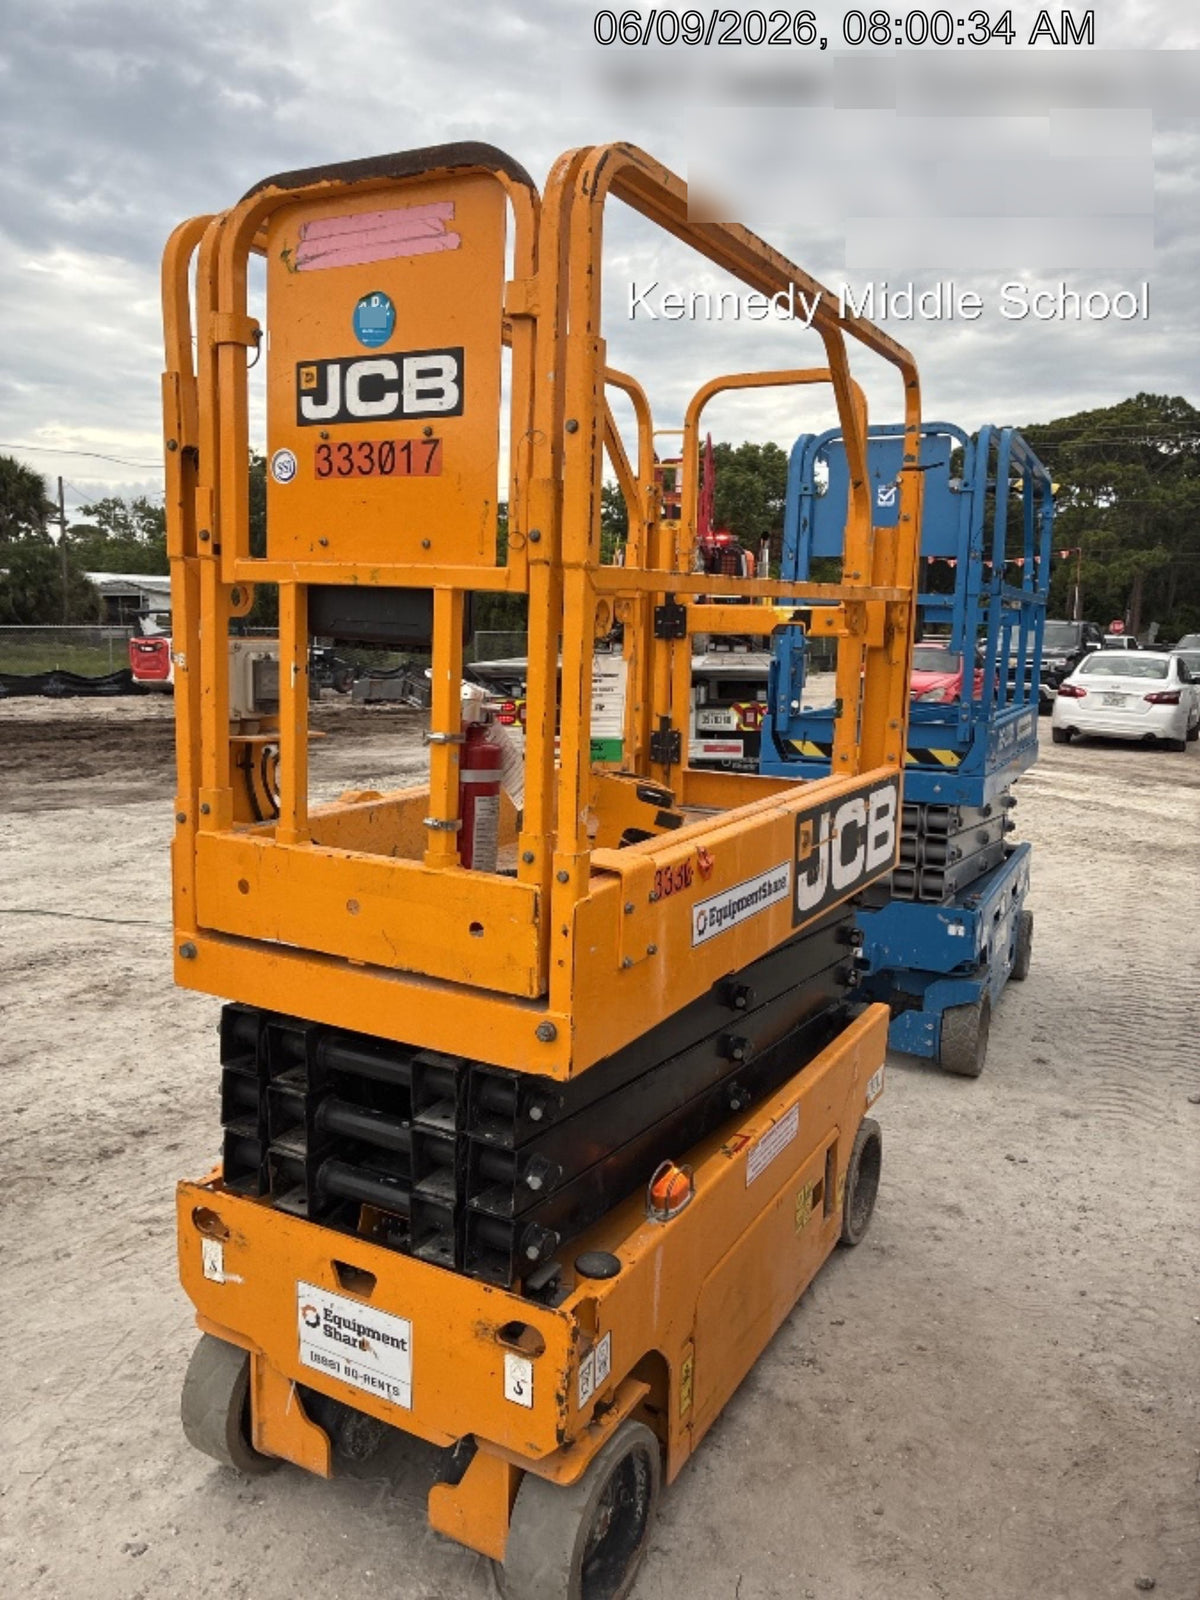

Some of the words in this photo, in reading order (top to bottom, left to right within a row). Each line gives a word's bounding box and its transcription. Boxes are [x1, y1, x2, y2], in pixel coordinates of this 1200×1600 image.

[301, 355, 459, 419] JCB
[317, 438, 440, 477] 333017
[798, 785, 897, 911] JCB
[709, 875, 788, 927] EquipmentShare
[323, 1307, 408, 1352] Equipment
